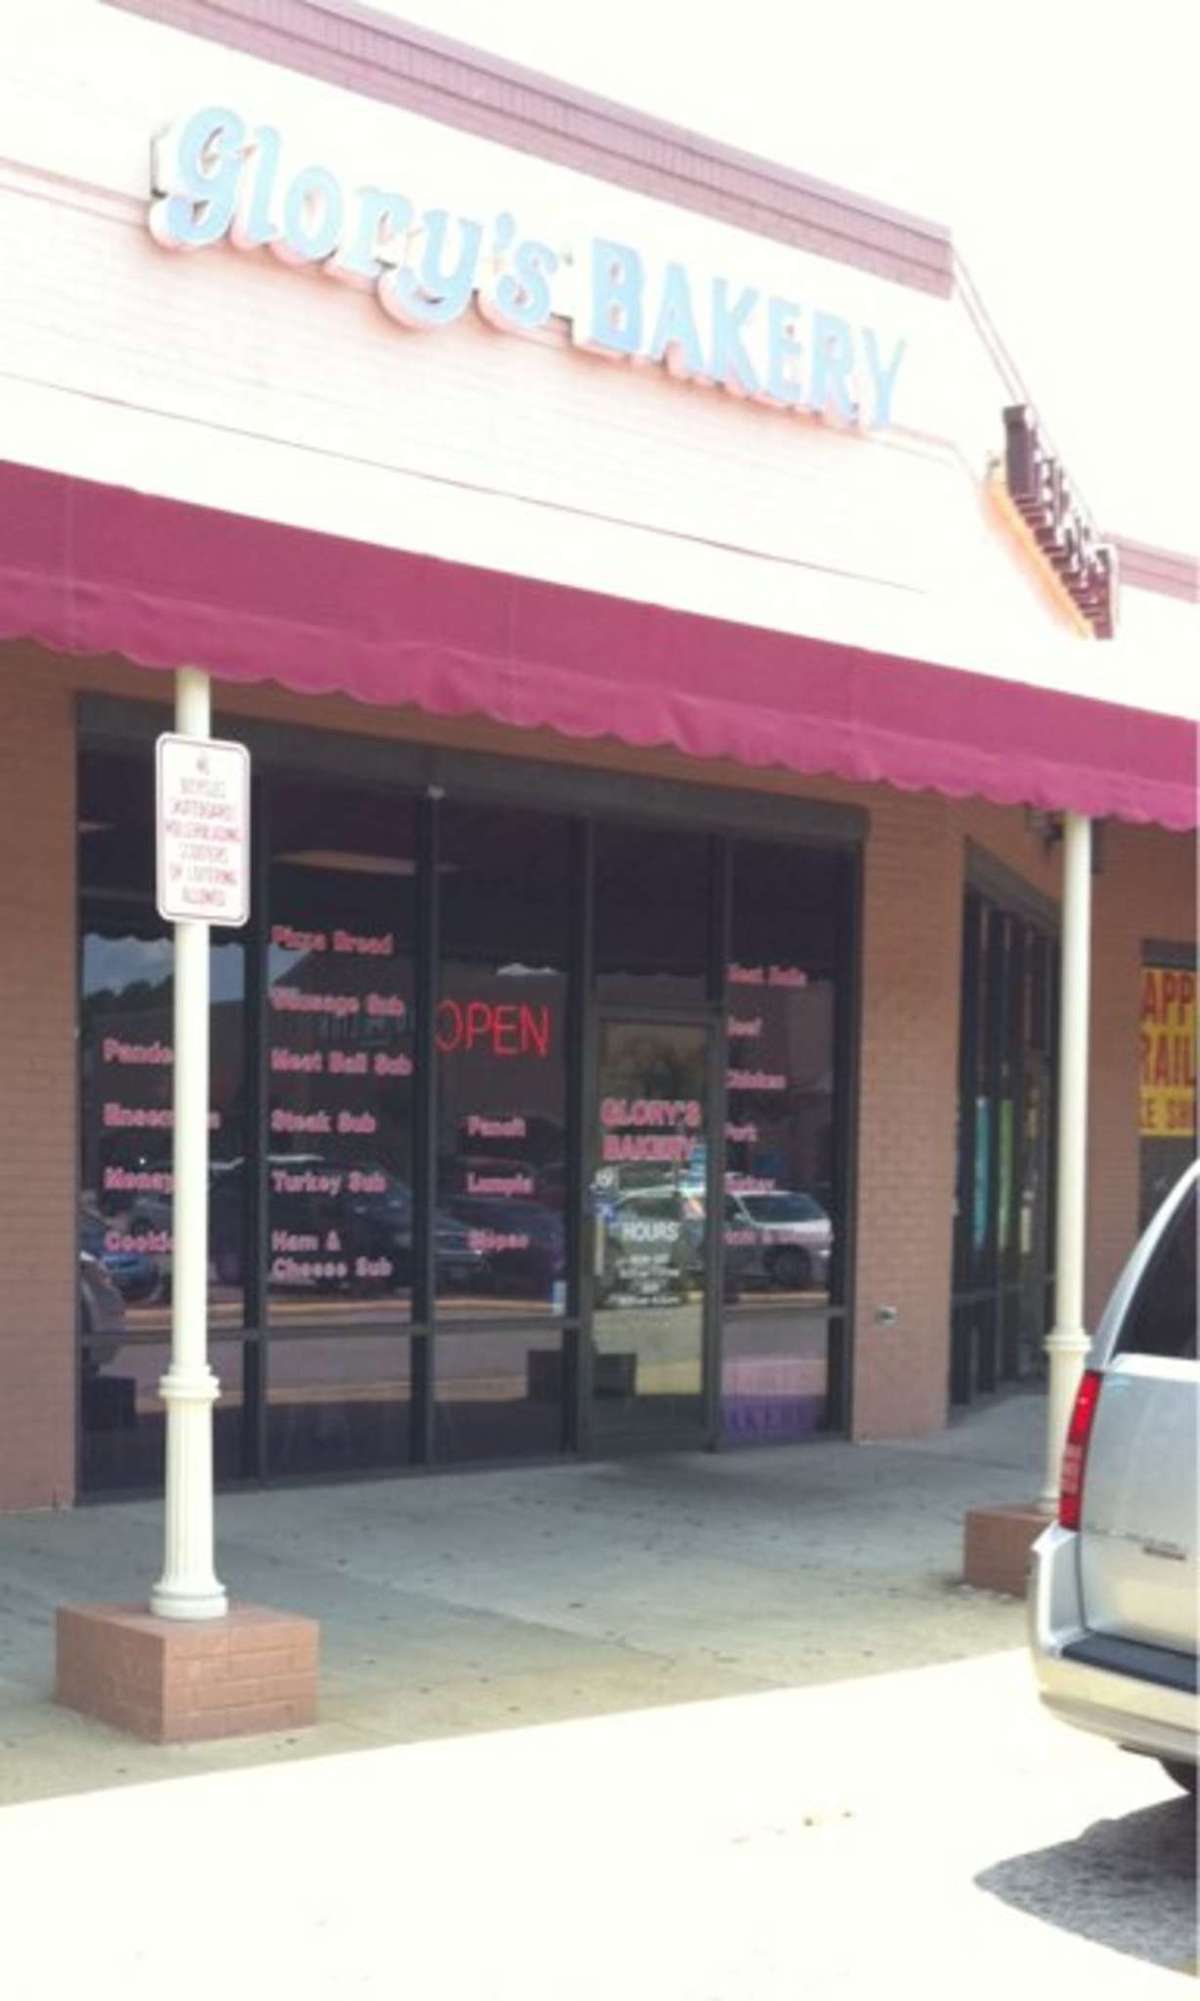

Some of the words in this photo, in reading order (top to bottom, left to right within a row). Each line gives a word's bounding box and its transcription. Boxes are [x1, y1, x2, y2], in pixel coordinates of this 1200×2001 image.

[163, 106, 559, 329] Glory's
[588, 236, 909, 433] BAKERY
[434, 999, 552, 1057] OPEN
[602, 1133, 694, 1162] BAKERY
[272, 1169, 343, 1197] Turkey
[271, 1230, 319, 1253] Ham
[621, 1221, 681, 1243] HOURS
